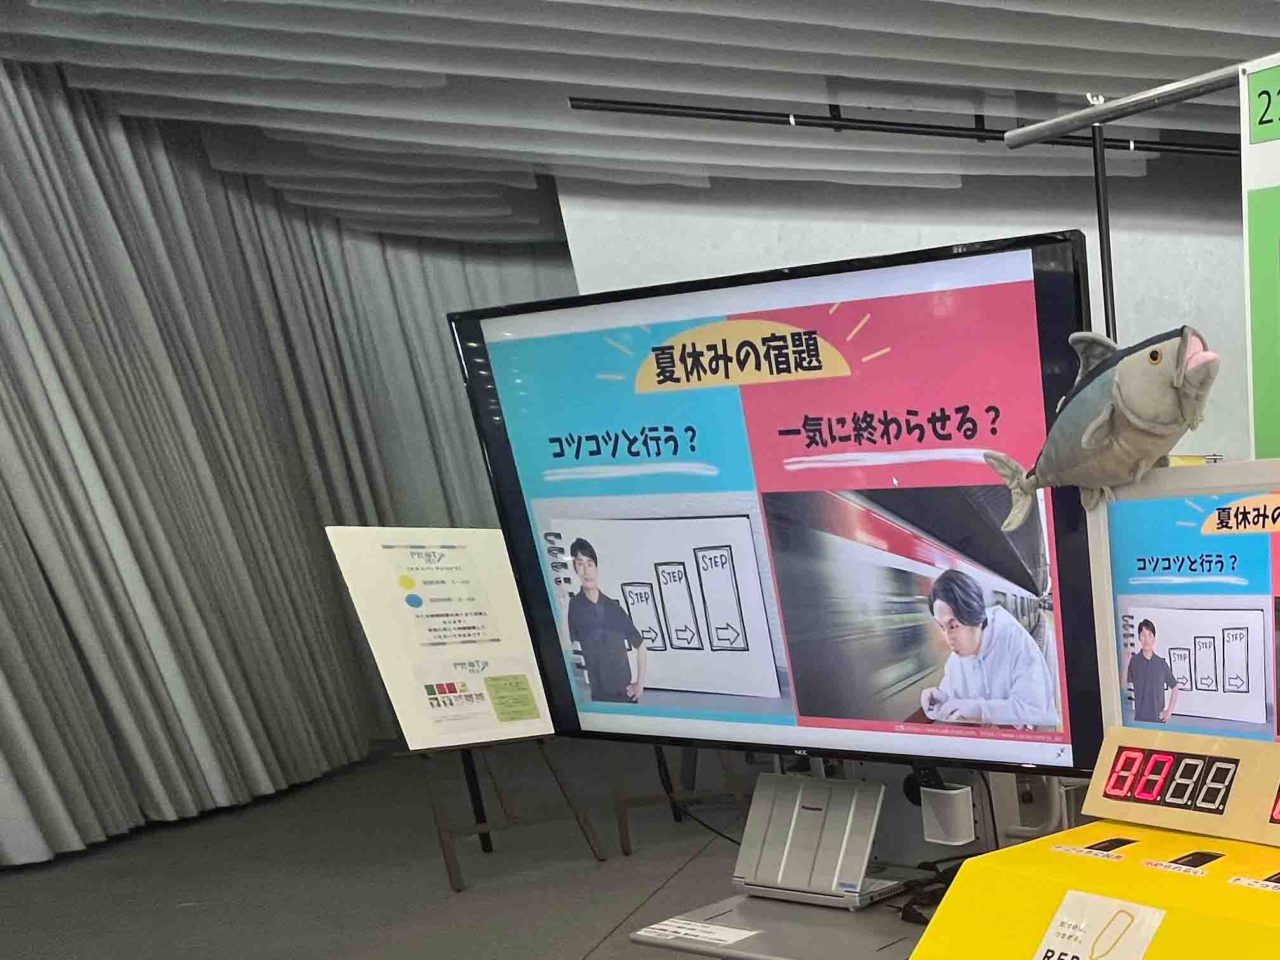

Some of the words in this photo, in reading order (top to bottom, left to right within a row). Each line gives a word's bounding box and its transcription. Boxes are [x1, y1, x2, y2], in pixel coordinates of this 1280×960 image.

[651, 328, 823, 385] 夏休みの宿題
[777, 405, 1002, 450] 一気に終わらせる？
[548, 425, 698, 460] コツコツと行う？
[702, 554, 728, 572] STEP
[1136, 554, 1239, 573] コツコツと行う？
[661, 568, 684, 588] STEP
[628, 590, 651, 607] STEP
[1197, 640, 1213, 651] STEP
[1226, 632, 1245, 644] STEP
[1172, 652, 1188, 663] STEP
